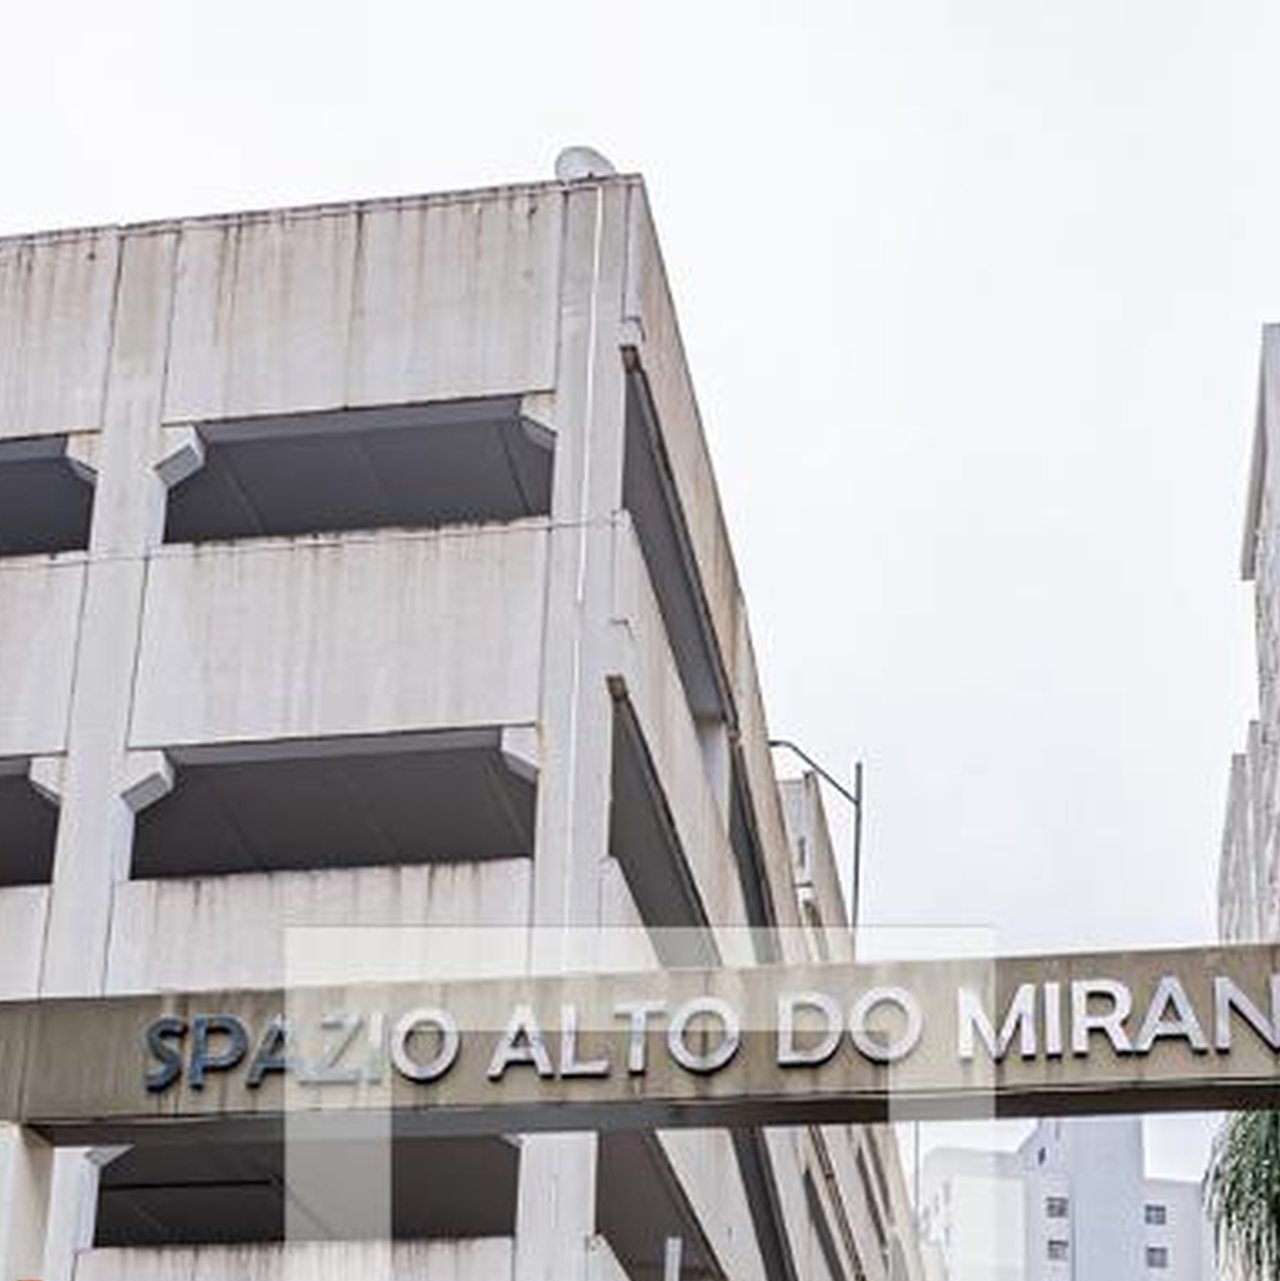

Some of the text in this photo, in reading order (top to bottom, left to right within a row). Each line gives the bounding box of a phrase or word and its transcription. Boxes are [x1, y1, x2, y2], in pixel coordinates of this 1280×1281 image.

[145, 1007, 460, 1092] SPAZIO
[487, 996, 741, 1081] ALTO
[776, 986, 923, 1067] DO
